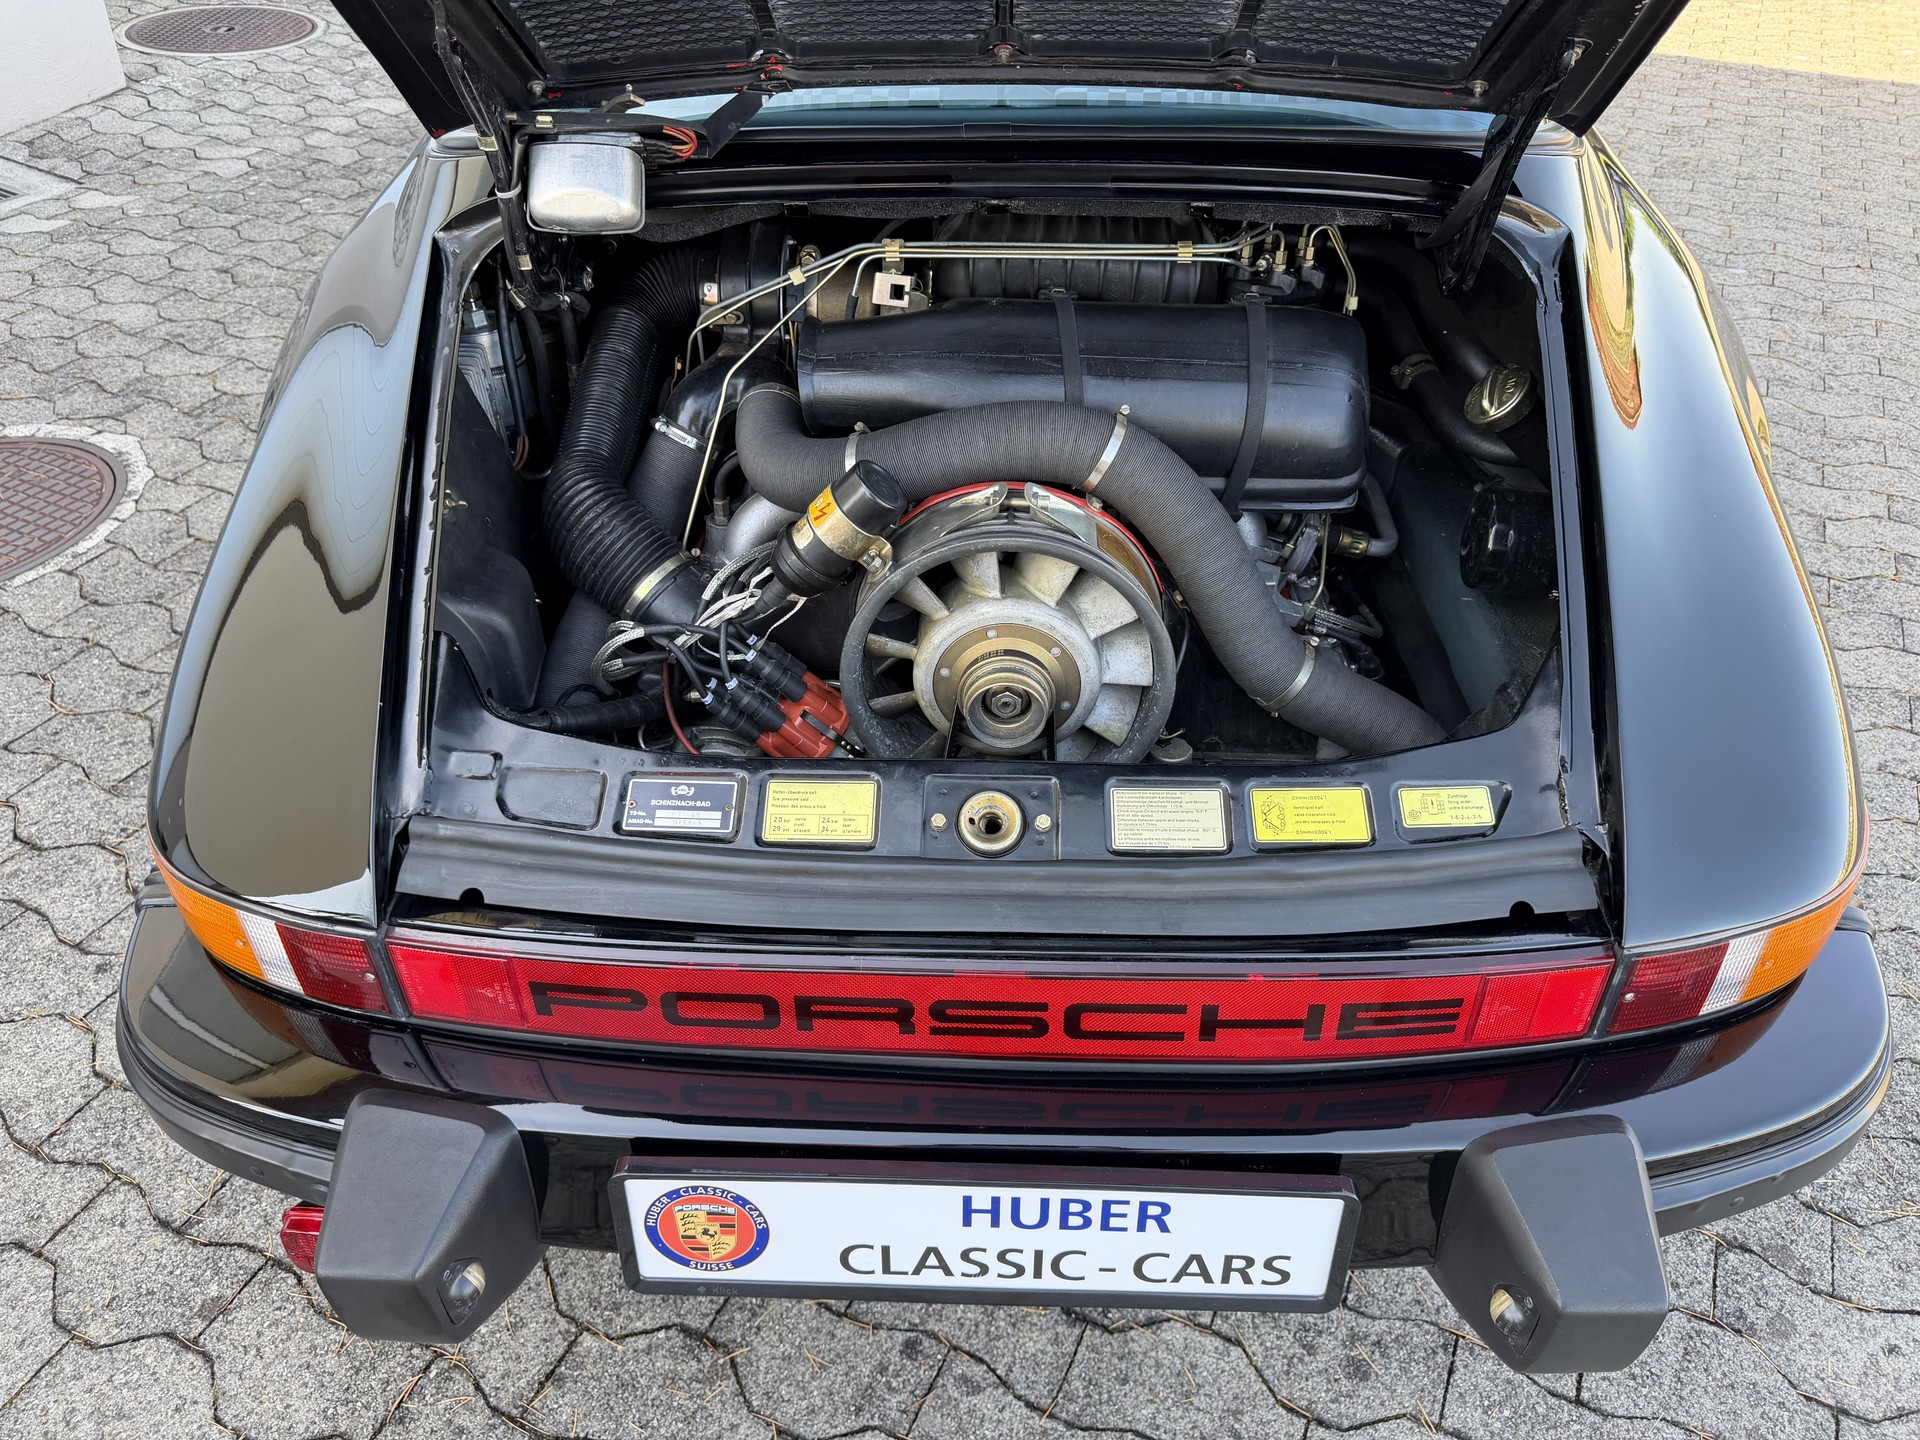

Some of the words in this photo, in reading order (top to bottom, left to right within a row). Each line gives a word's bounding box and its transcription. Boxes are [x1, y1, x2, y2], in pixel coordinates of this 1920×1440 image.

[650, 799, 711, 807] SCHINZNACH-BAD
[528, 981, 1464, 1042] PORSCHE
[646, 1196, 671, 1226] HUBER
[680, 1186, 737, 1201] CLASSIC
[745, 1204, 767, 1229] CARS
[674, 1204, 736, 1214] PORSCHE
[961, 1195, 1172, 1233] HUBER
[689, 1261, 734, 1271] SUISSE
[838, 1244, 1088, 1281] CLASSIC
[1132, 1252, 1292, 1286] CARS
[712, 1286, 738, 1295] Klick
